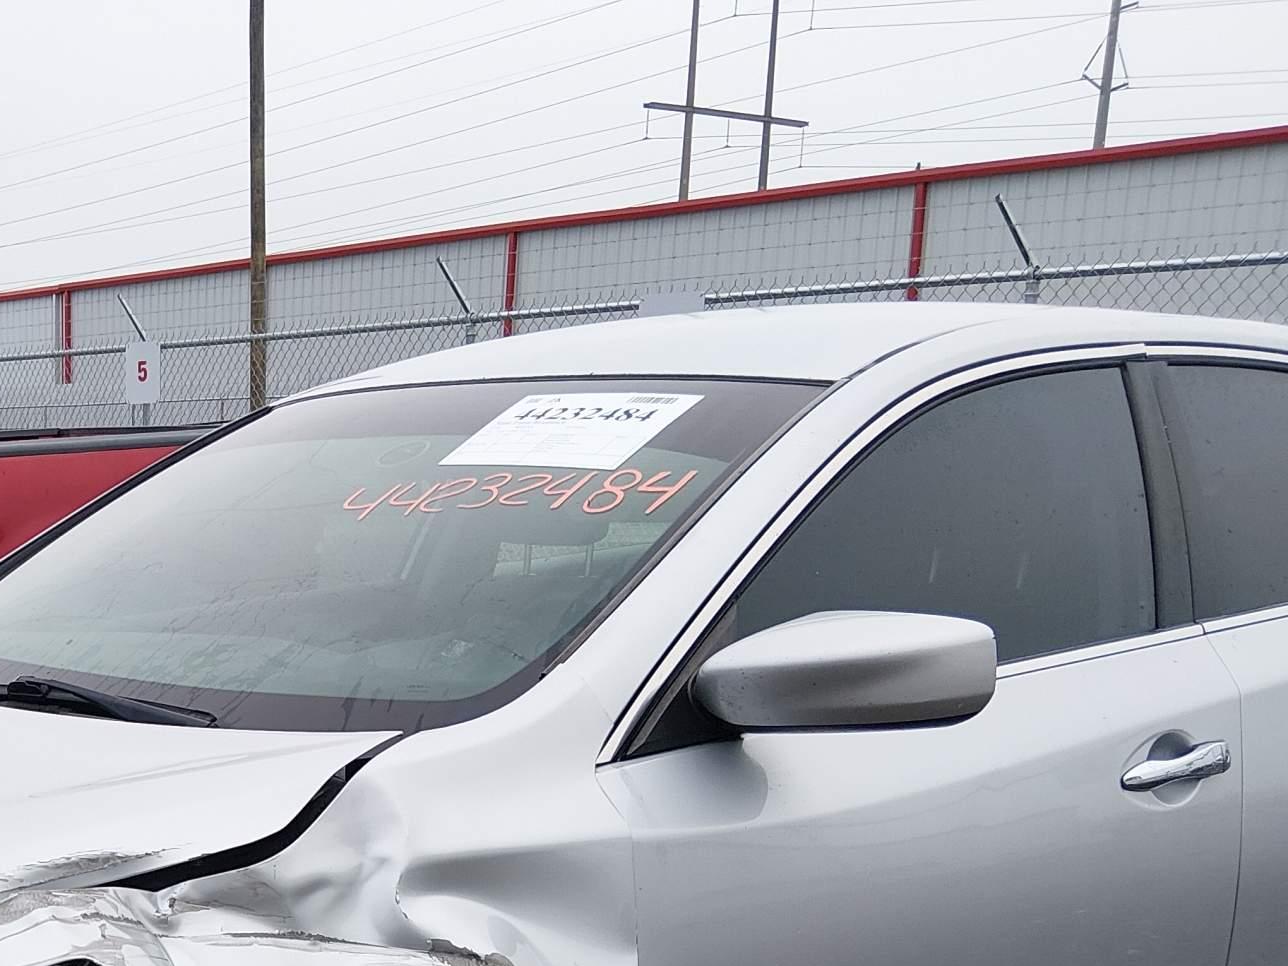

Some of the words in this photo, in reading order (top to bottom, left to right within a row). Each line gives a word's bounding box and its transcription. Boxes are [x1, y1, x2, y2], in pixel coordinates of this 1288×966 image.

[137, 360, 148, 383] 5
[514, 407, 658, 422] 44232484
[343, 469, 698, 521] 44232484
